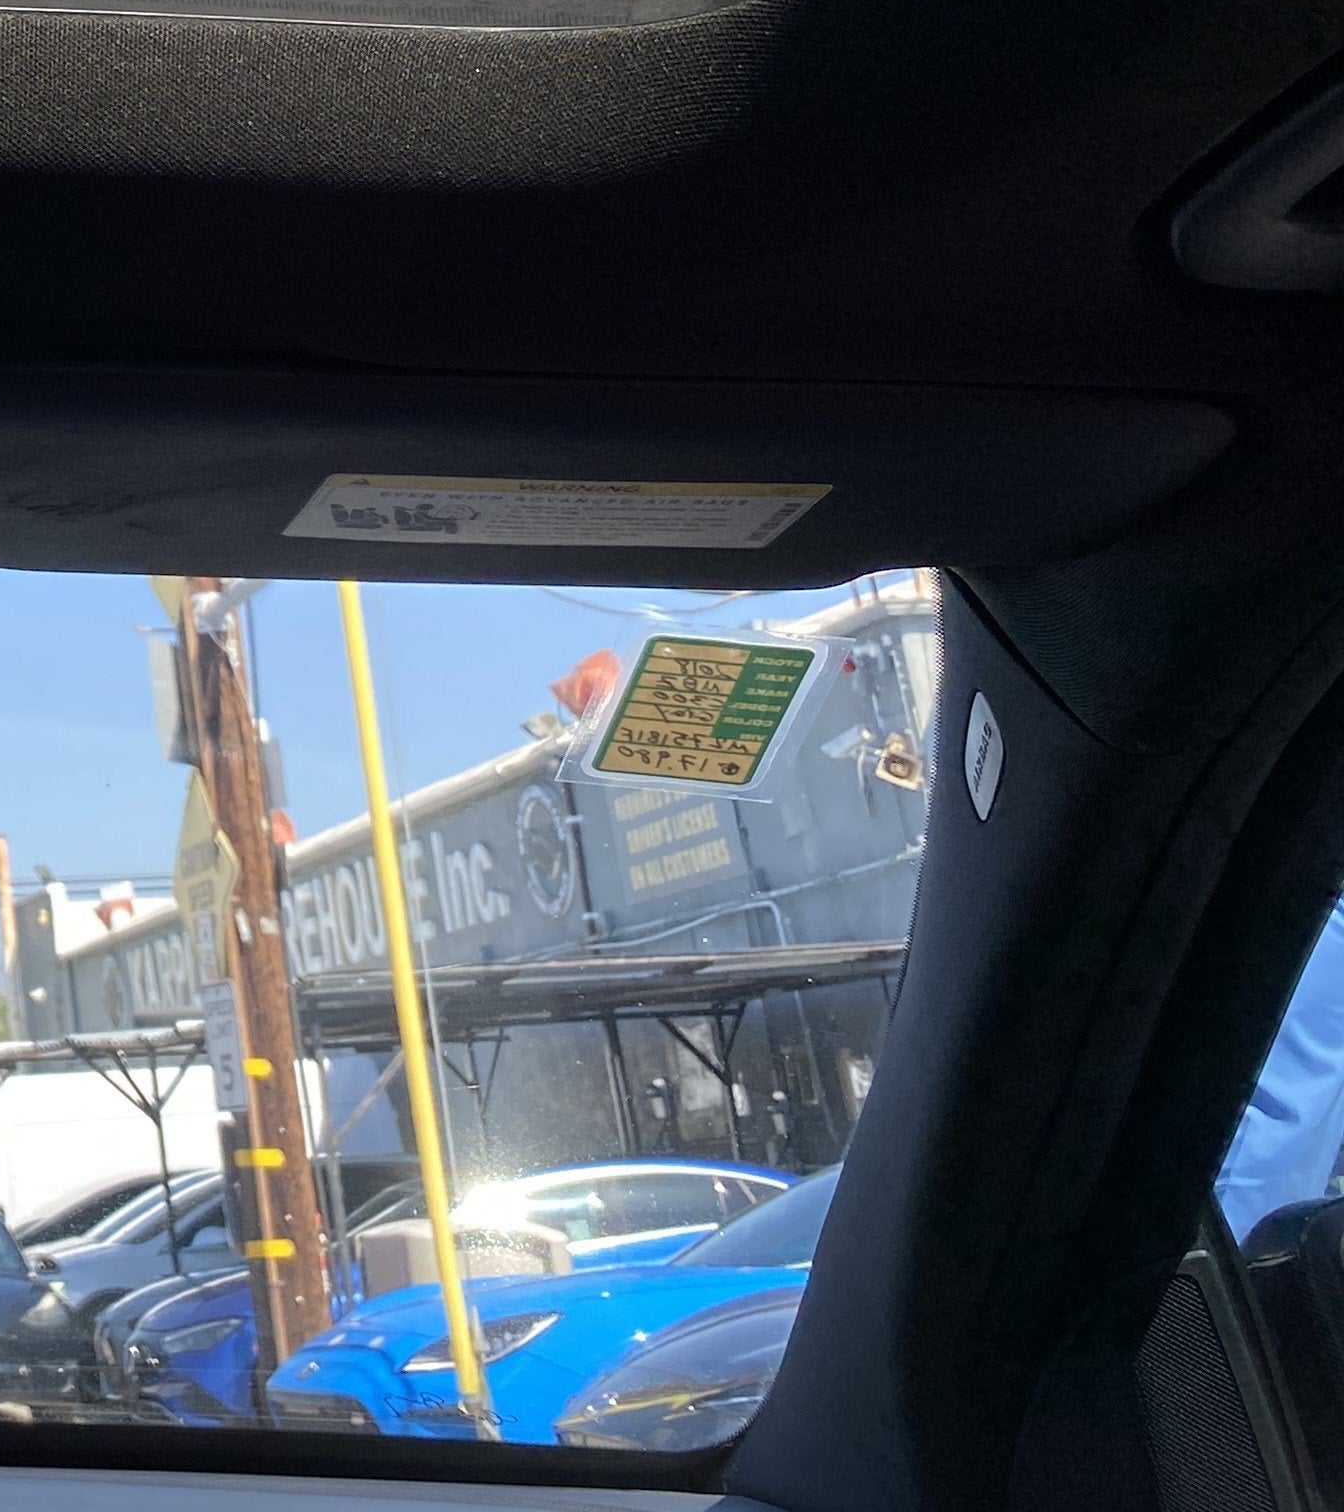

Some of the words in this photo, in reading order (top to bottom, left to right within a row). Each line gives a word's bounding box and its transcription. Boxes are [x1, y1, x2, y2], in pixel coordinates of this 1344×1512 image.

[518, 481, 641, 493] WARNING
[280, 839, 437, 977] REHOUE
[430, 831, 512, 935] Inc.
[220, 1052, 234, 1092] 5
